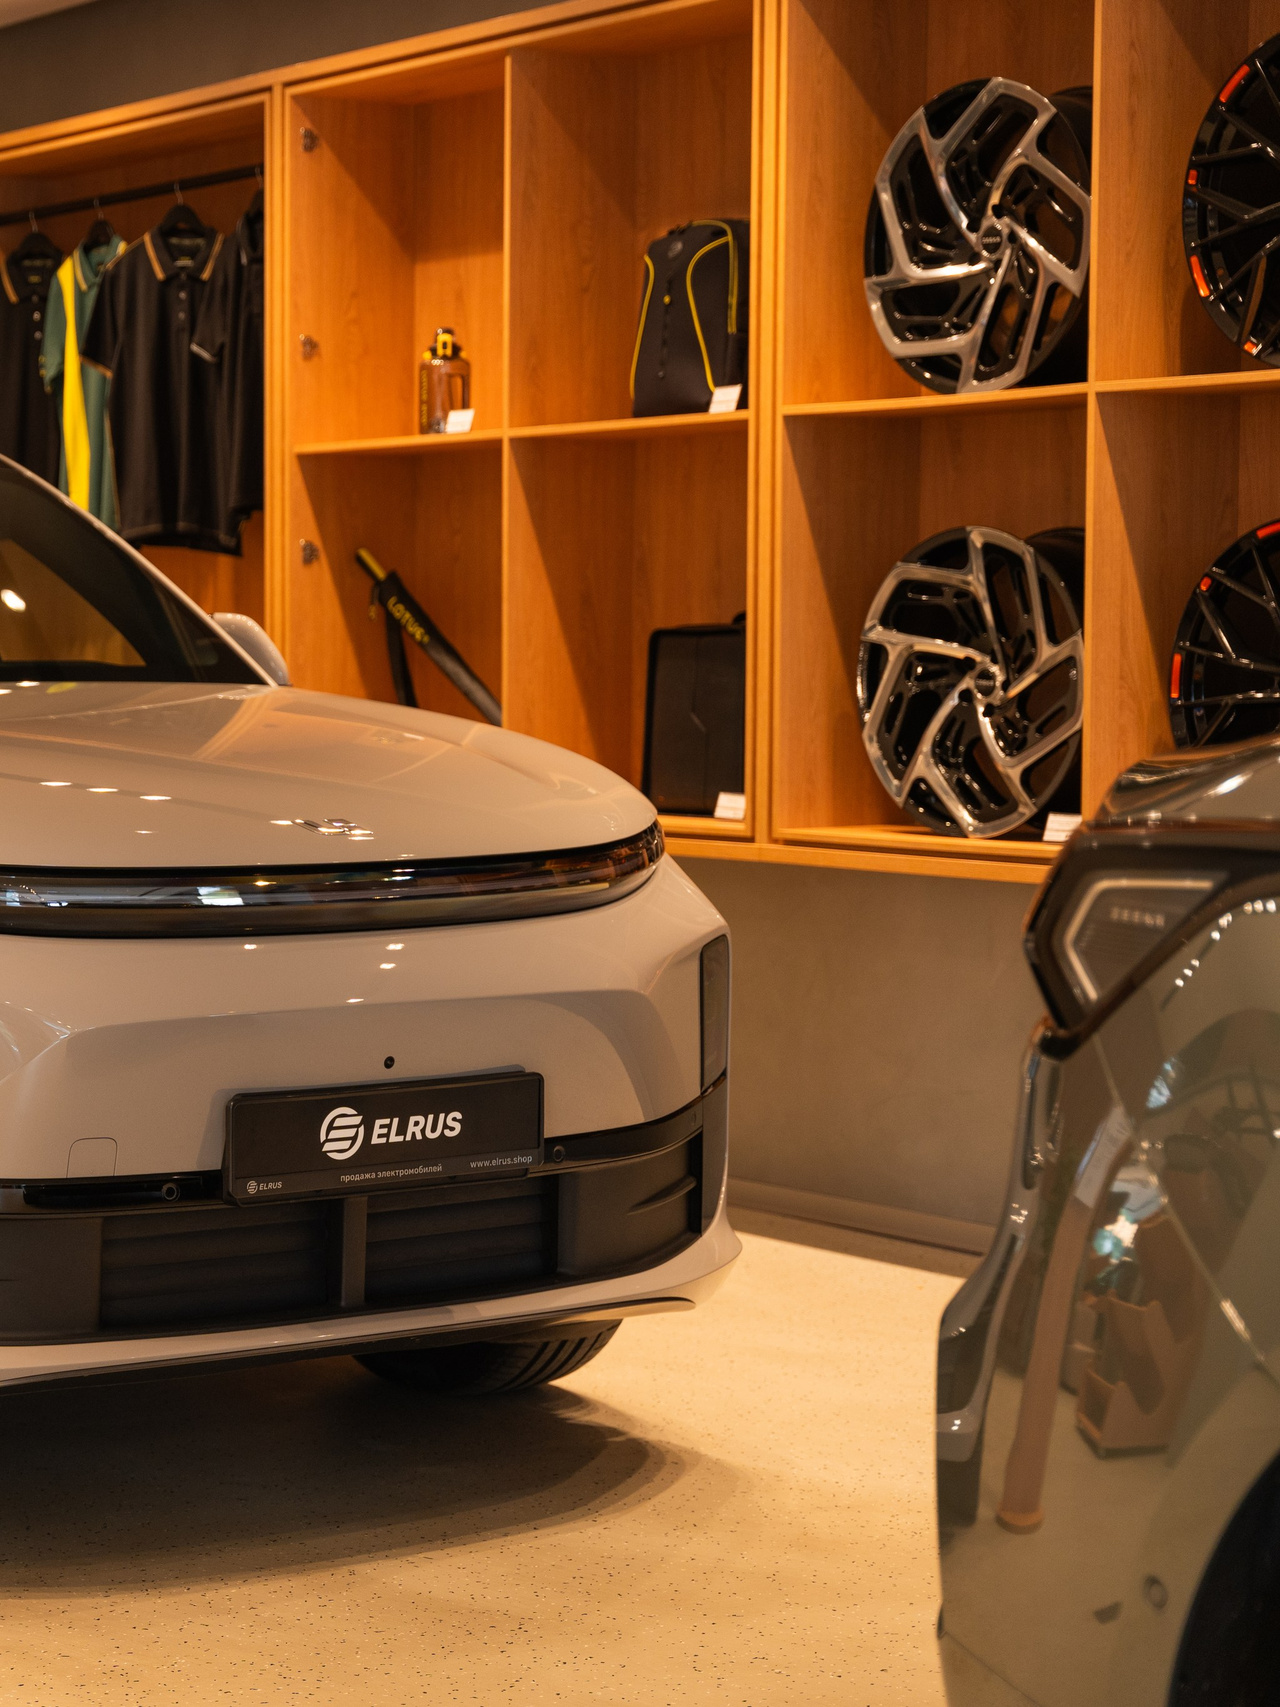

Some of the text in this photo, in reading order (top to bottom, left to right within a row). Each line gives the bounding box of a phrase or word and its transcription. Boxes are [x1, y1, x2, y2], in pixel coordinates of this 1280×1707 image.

[387, 596, 425, 642] LOTUS
[370, 1111, 463, 1145] ELRUS
[470, 1154, 532, 1169] www.elrus.shop
[340, 1163, 443, 1183] продажа электромобилей
[259, 1181, 283, 1191] ELRUS
